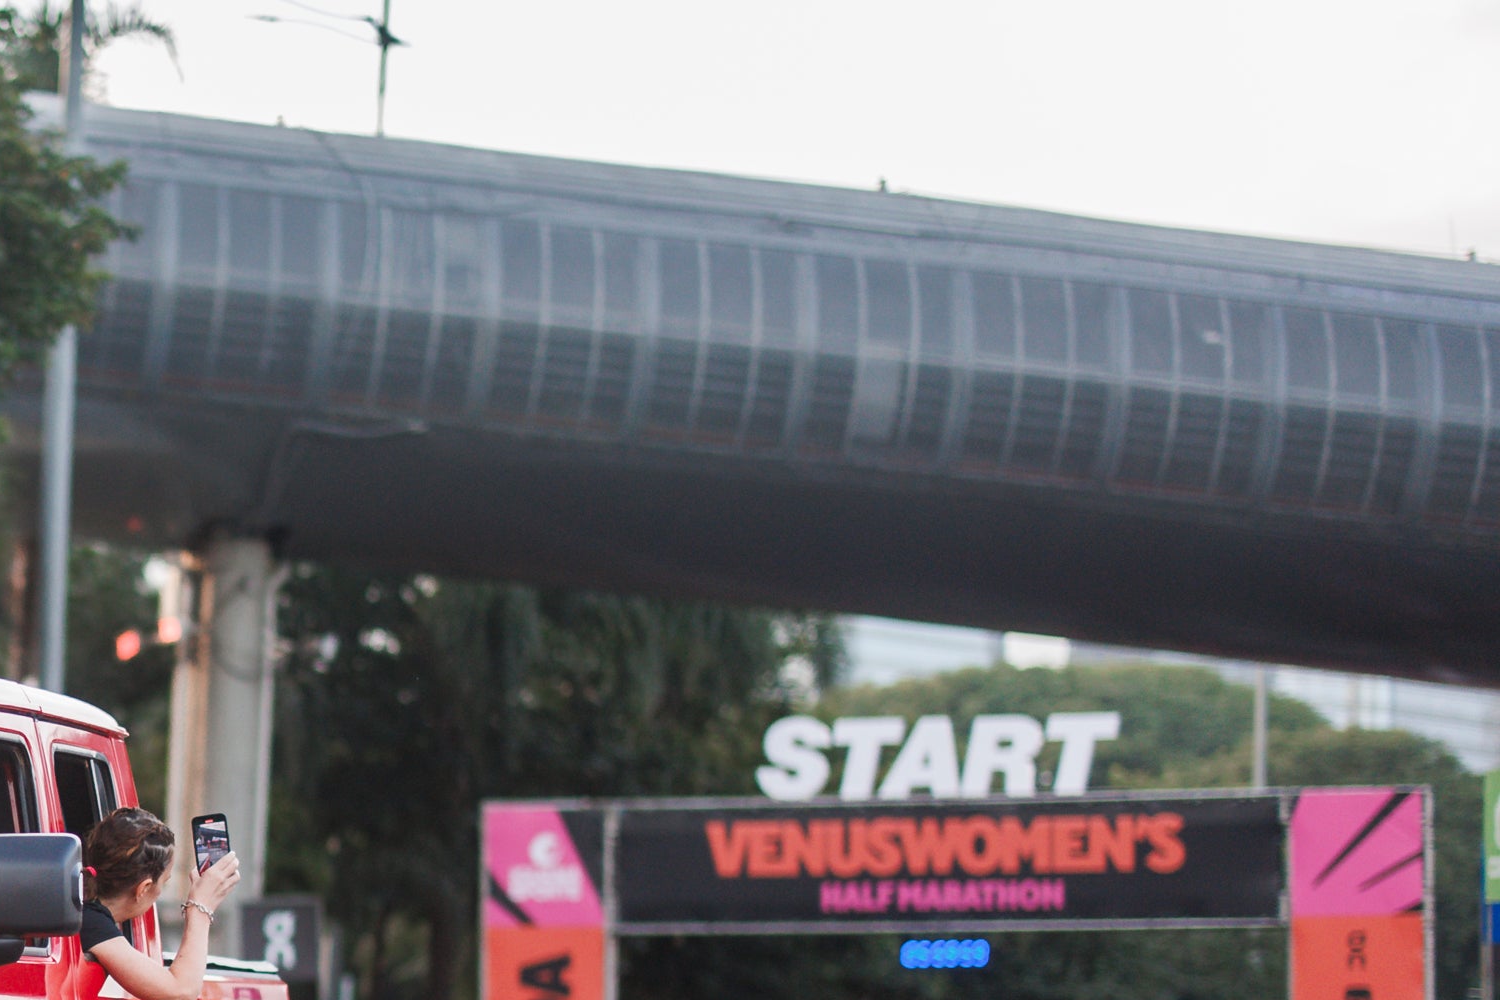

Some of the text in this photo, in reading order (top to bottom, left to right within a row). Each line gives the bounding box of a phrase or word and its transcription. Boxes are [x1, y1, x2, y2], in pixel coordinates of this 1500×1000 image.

[754, 711, 1122, 801] START
[820, 878, 1066, 913] HALF MARATHON
